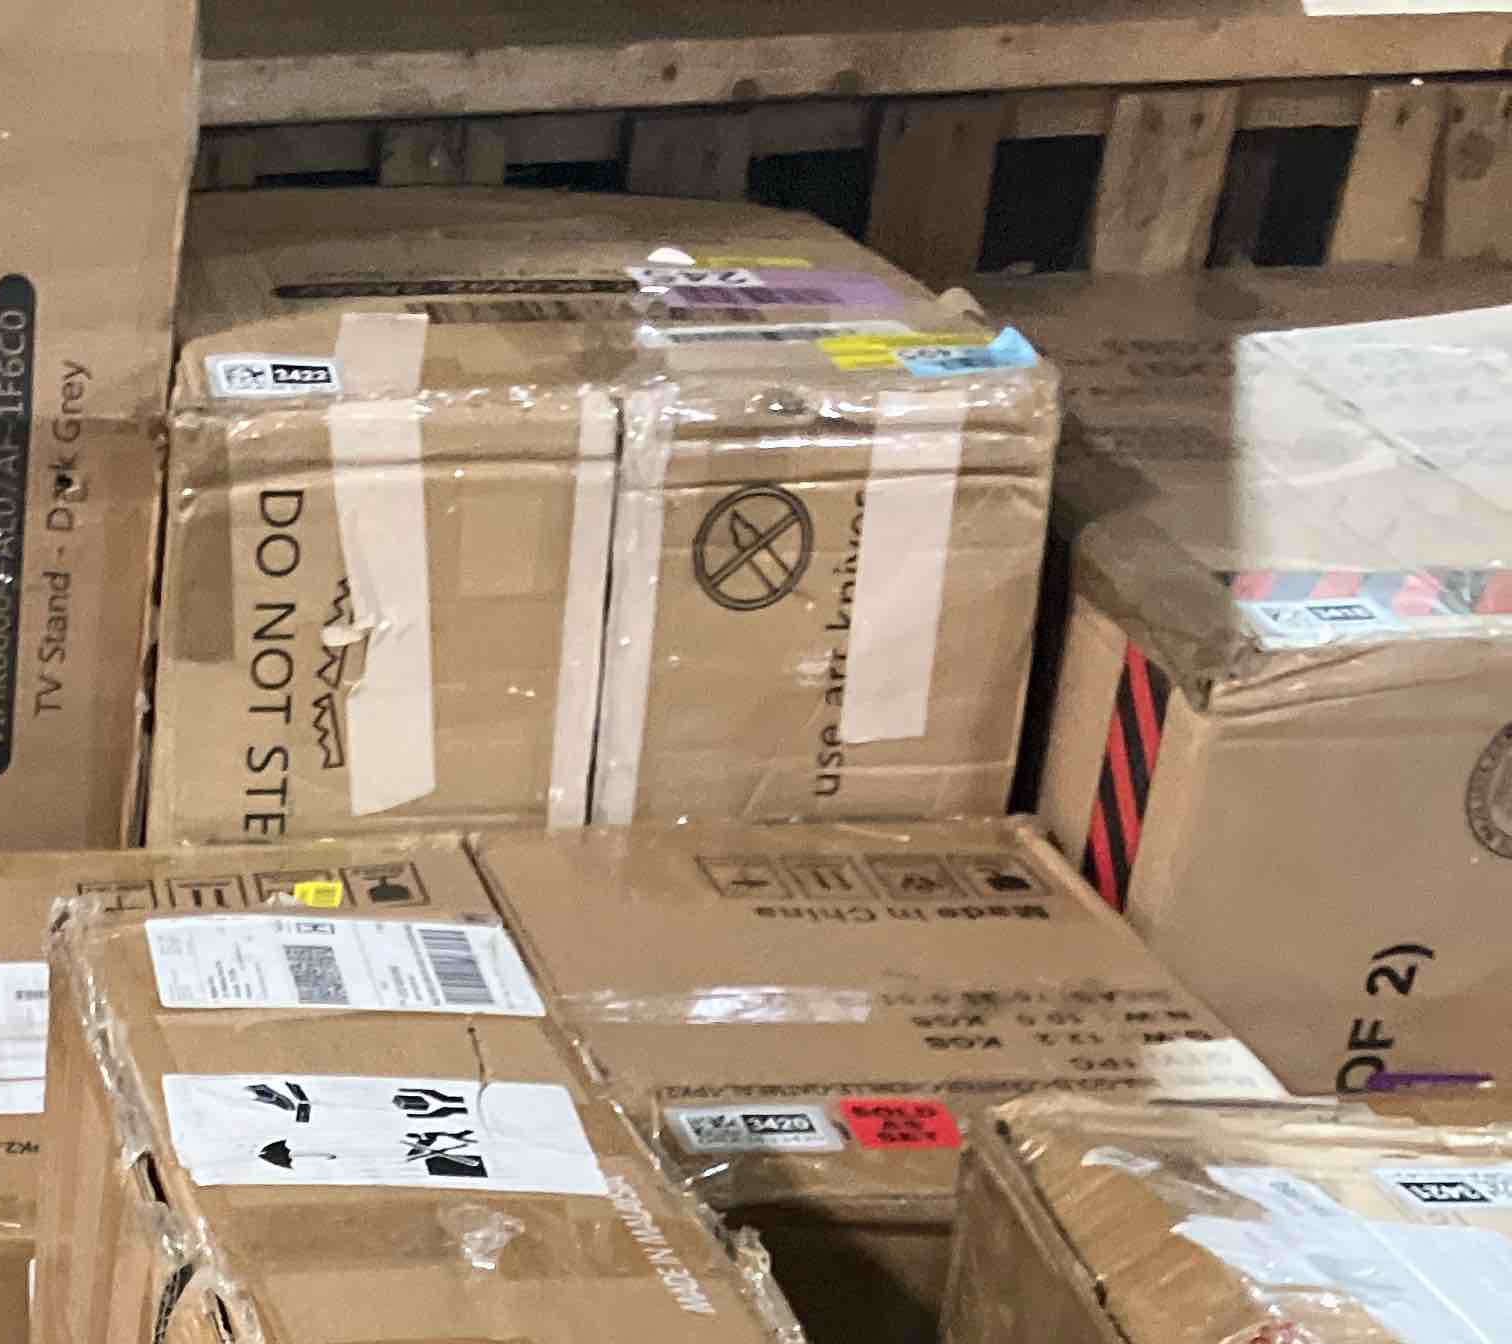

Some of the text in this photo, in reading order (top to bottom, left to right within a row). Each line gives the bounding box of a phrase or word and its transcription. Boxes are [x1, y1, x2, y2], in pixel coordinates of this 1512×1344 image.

[51, 361, 91, 443] Grey
[46, 456, 78, 531] Dk
[257, 490, 305, 578] DO
[38, 571, 73, 664] Stand
[34, 671, 66, 717] TV
[248, 602, 300, 727] NOT
[815, 724, 843, 797] use
[752, 905, 876, 923] China
[1366, 944, 1437, 998] 2)
